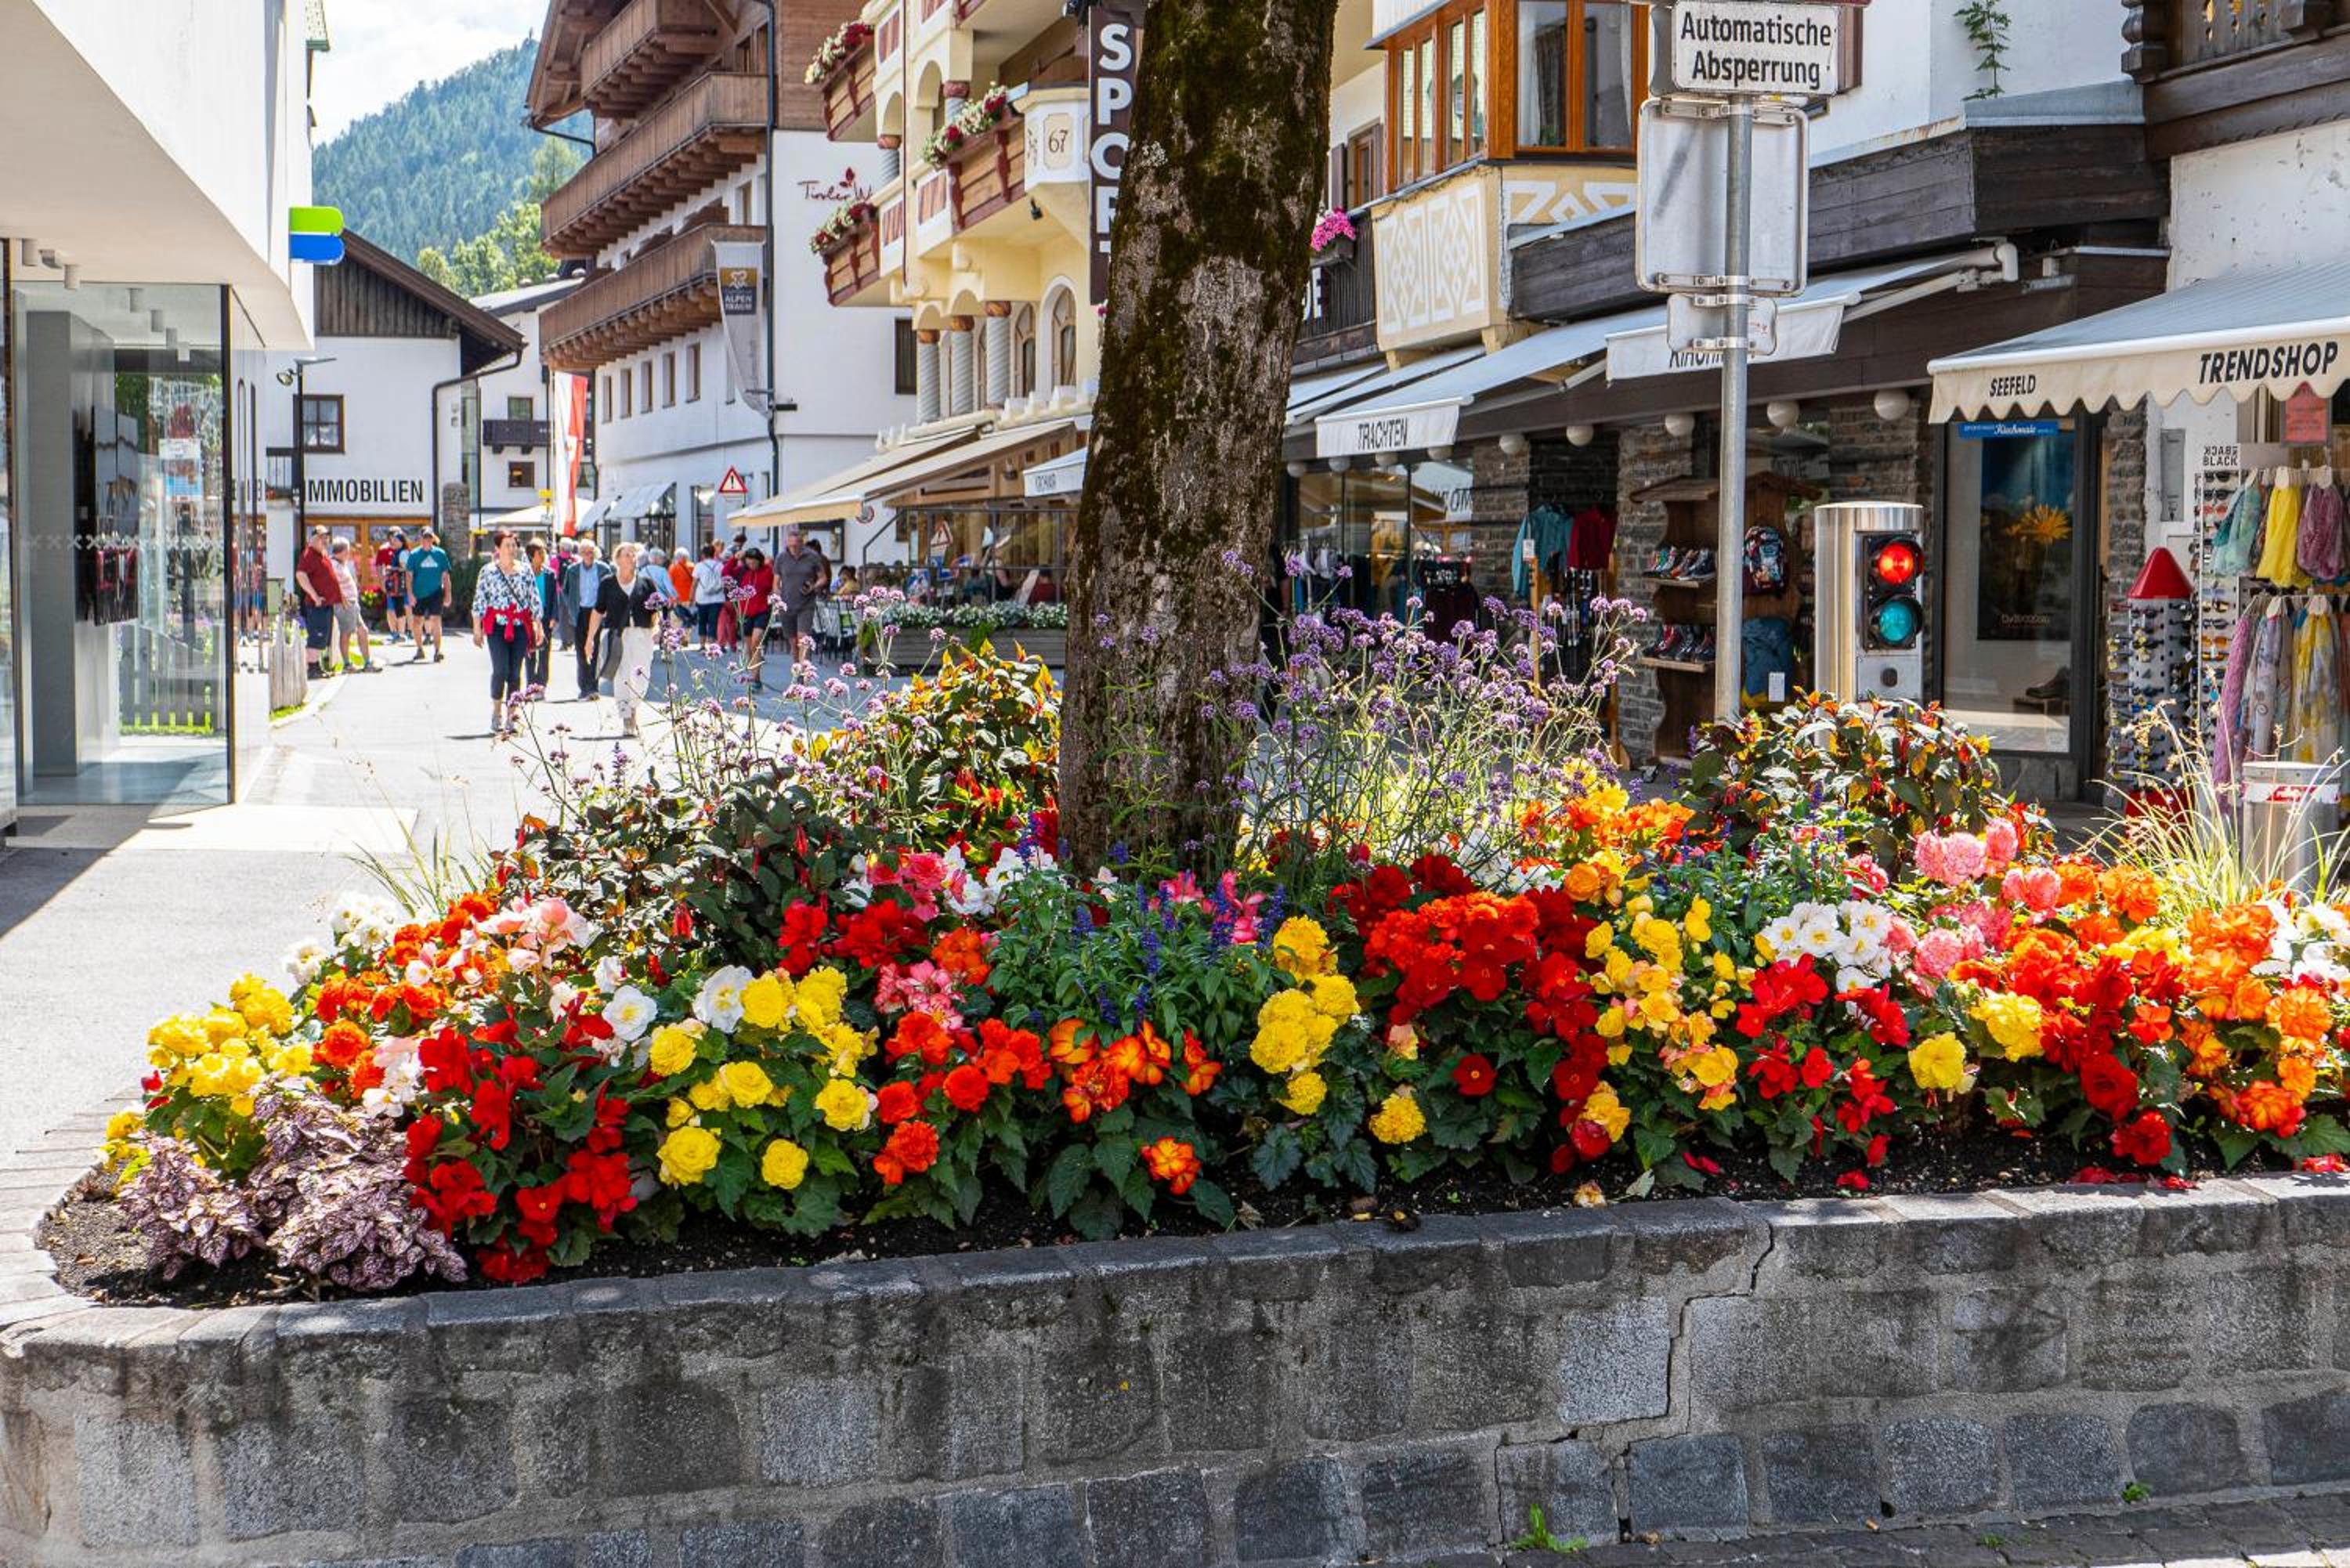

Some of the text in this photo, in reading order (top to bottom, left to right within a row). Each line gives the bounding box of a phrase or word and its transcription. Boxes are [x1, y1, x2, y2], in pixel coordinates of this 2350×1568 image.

[1681, 12, 1831, 46] Automatische
[1692, 50, 1820, 90] Absperrung
[1049, 129, 1068, 153] 67
[1090, 23, 1133, 253] SPOR
[2199, 341, 2338, 385] TRENDSHOP
[1990, 374, 2037, 397] SEEFELD
[1358, 417, 1408, 450] TRACHTEN
[2203, 456, 2238, 466] BLACK
[303, 479, 424, 503] MMOBILIEN
